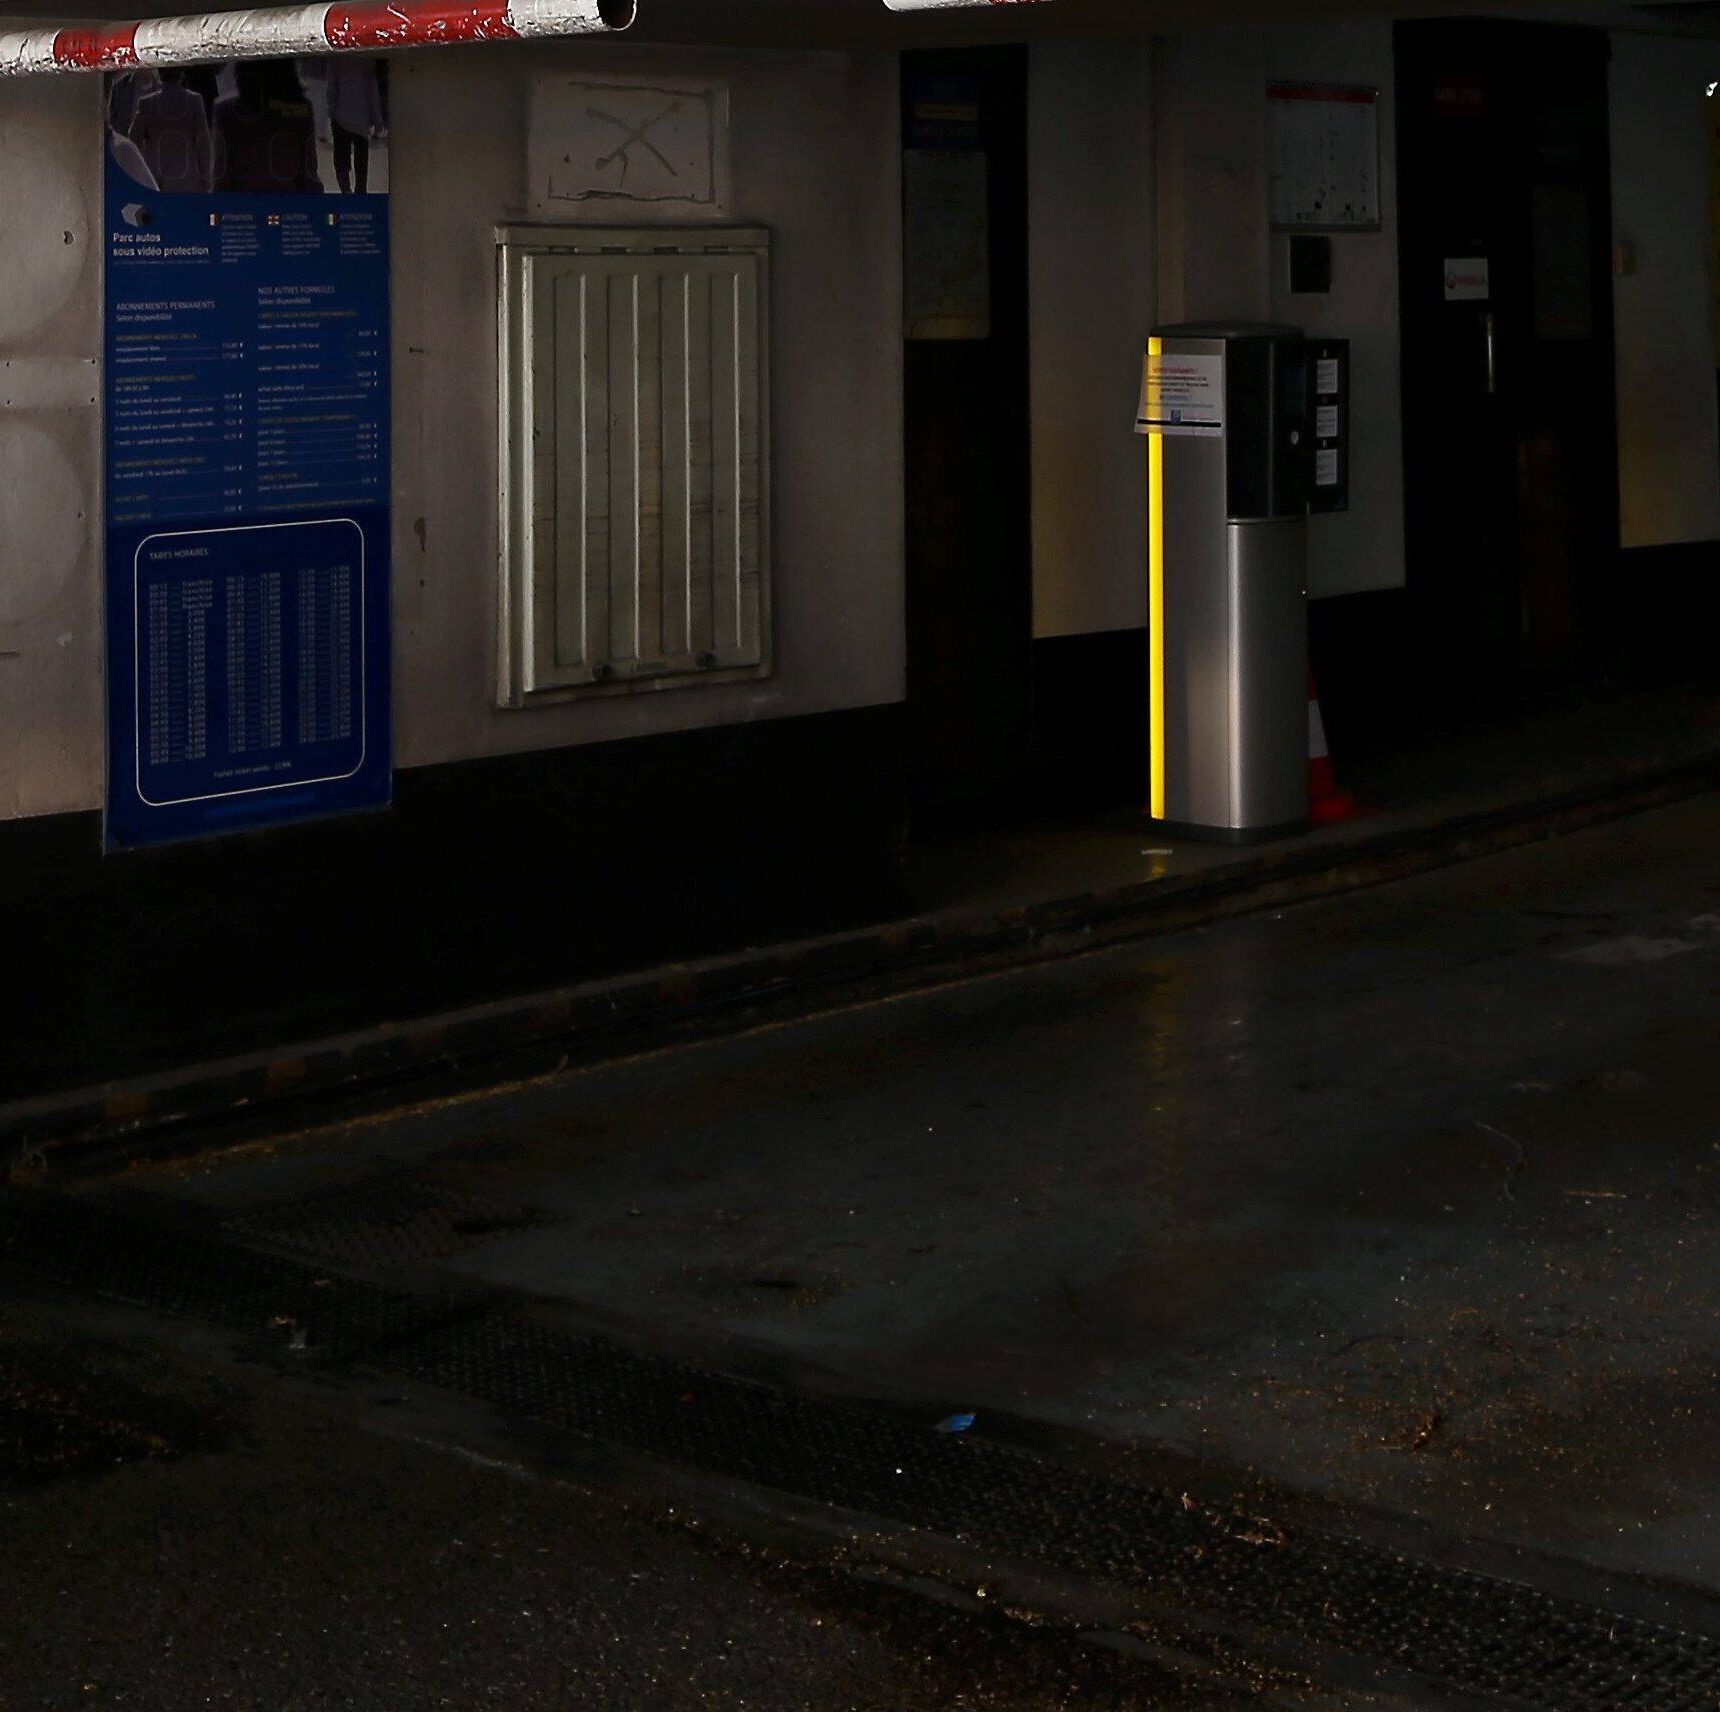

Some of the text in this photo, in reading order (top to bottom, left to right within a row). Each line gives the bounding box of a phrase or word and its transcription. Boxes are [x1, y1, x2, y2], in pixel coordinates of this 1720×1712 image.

[113, 232, 161, 243] Parc autos
[113, 245, 209, 258] sous vidéo protection
